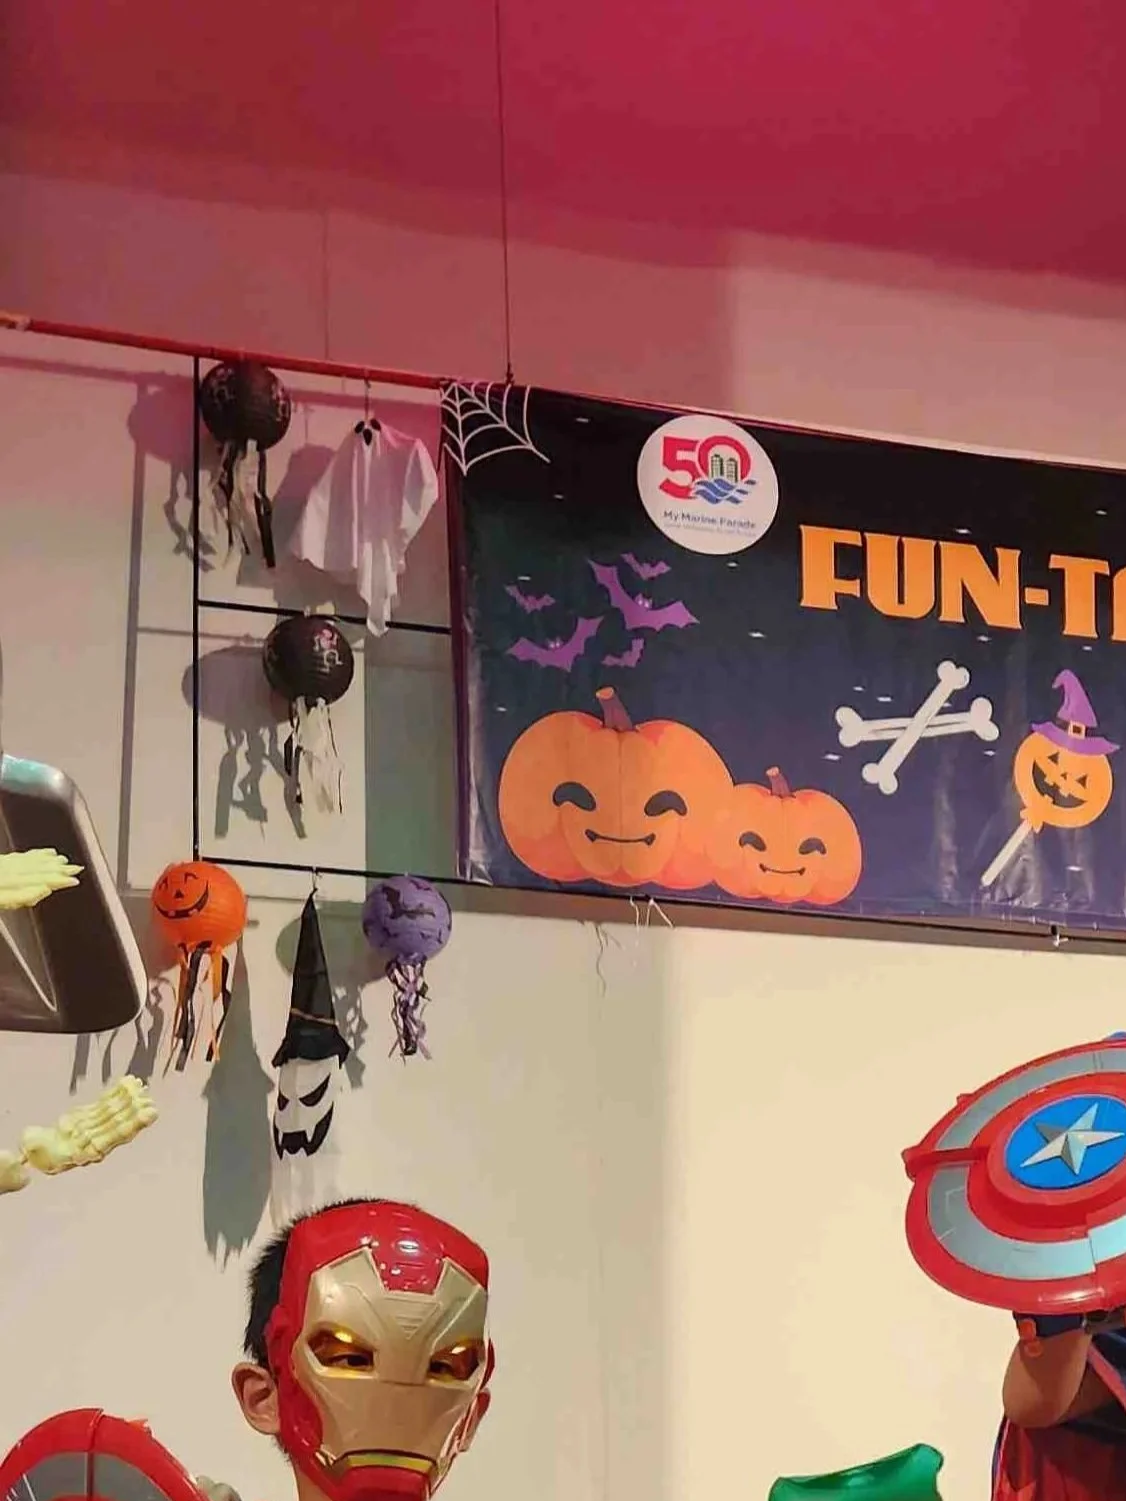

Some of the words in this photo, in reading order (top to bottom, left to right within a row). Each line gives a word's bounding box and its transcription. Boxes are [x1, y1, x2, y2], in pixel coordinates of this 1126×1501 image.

[659, 435, 752, 500] 50
[663, 509, 679, 520] My
[681, 512, 717, 525] Marine
[719, 516, 756, 529] Parade
